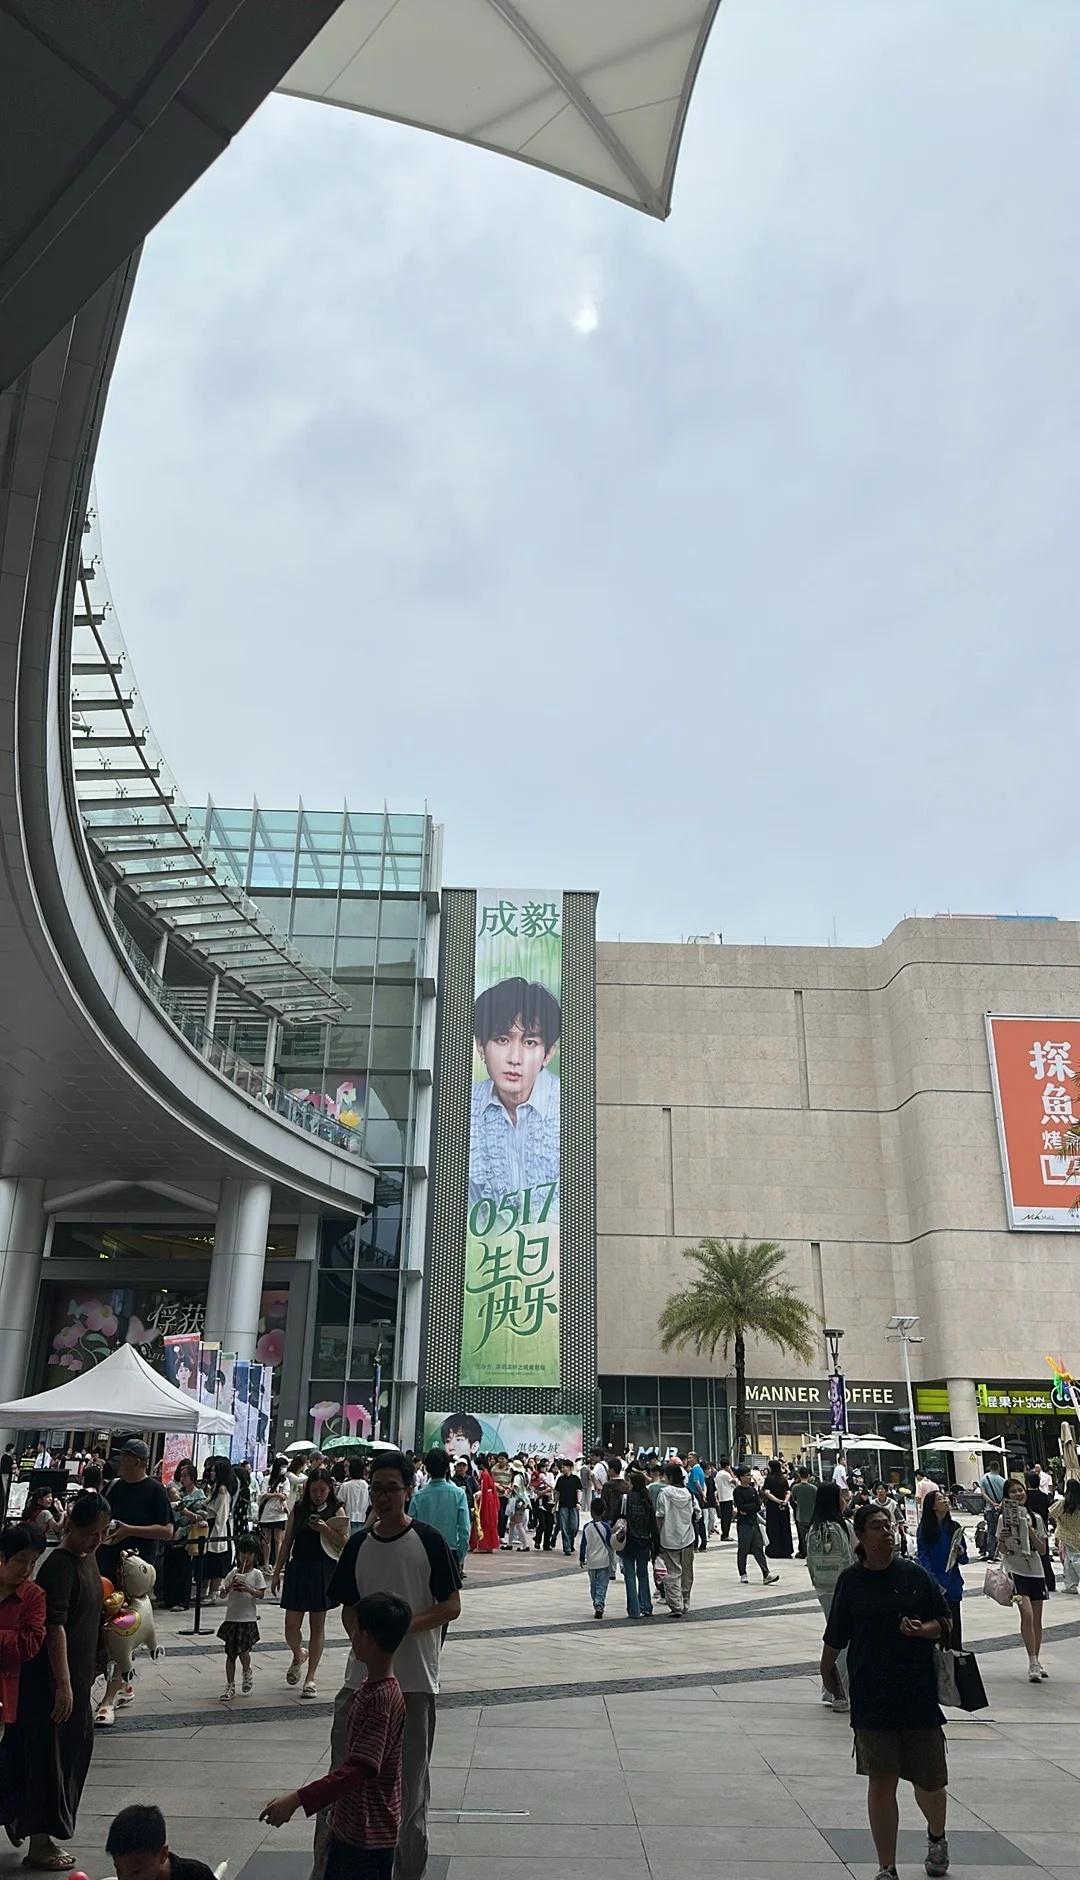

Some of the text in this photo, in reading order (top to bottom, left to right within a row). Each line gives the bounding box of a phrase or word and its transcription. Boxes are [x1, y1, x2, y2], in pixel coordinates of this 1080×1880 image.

[477, 900, 561, 938] 成毅
[468, 1181, 558, 1237] 0517
[465, 1229, 550, 1293] 生日
[470, 1270, 558, 1355] 快乐
[745, 1385, 894, 1404] MANNER OFFEE
[636, 1446, 679, 1461] MLB
